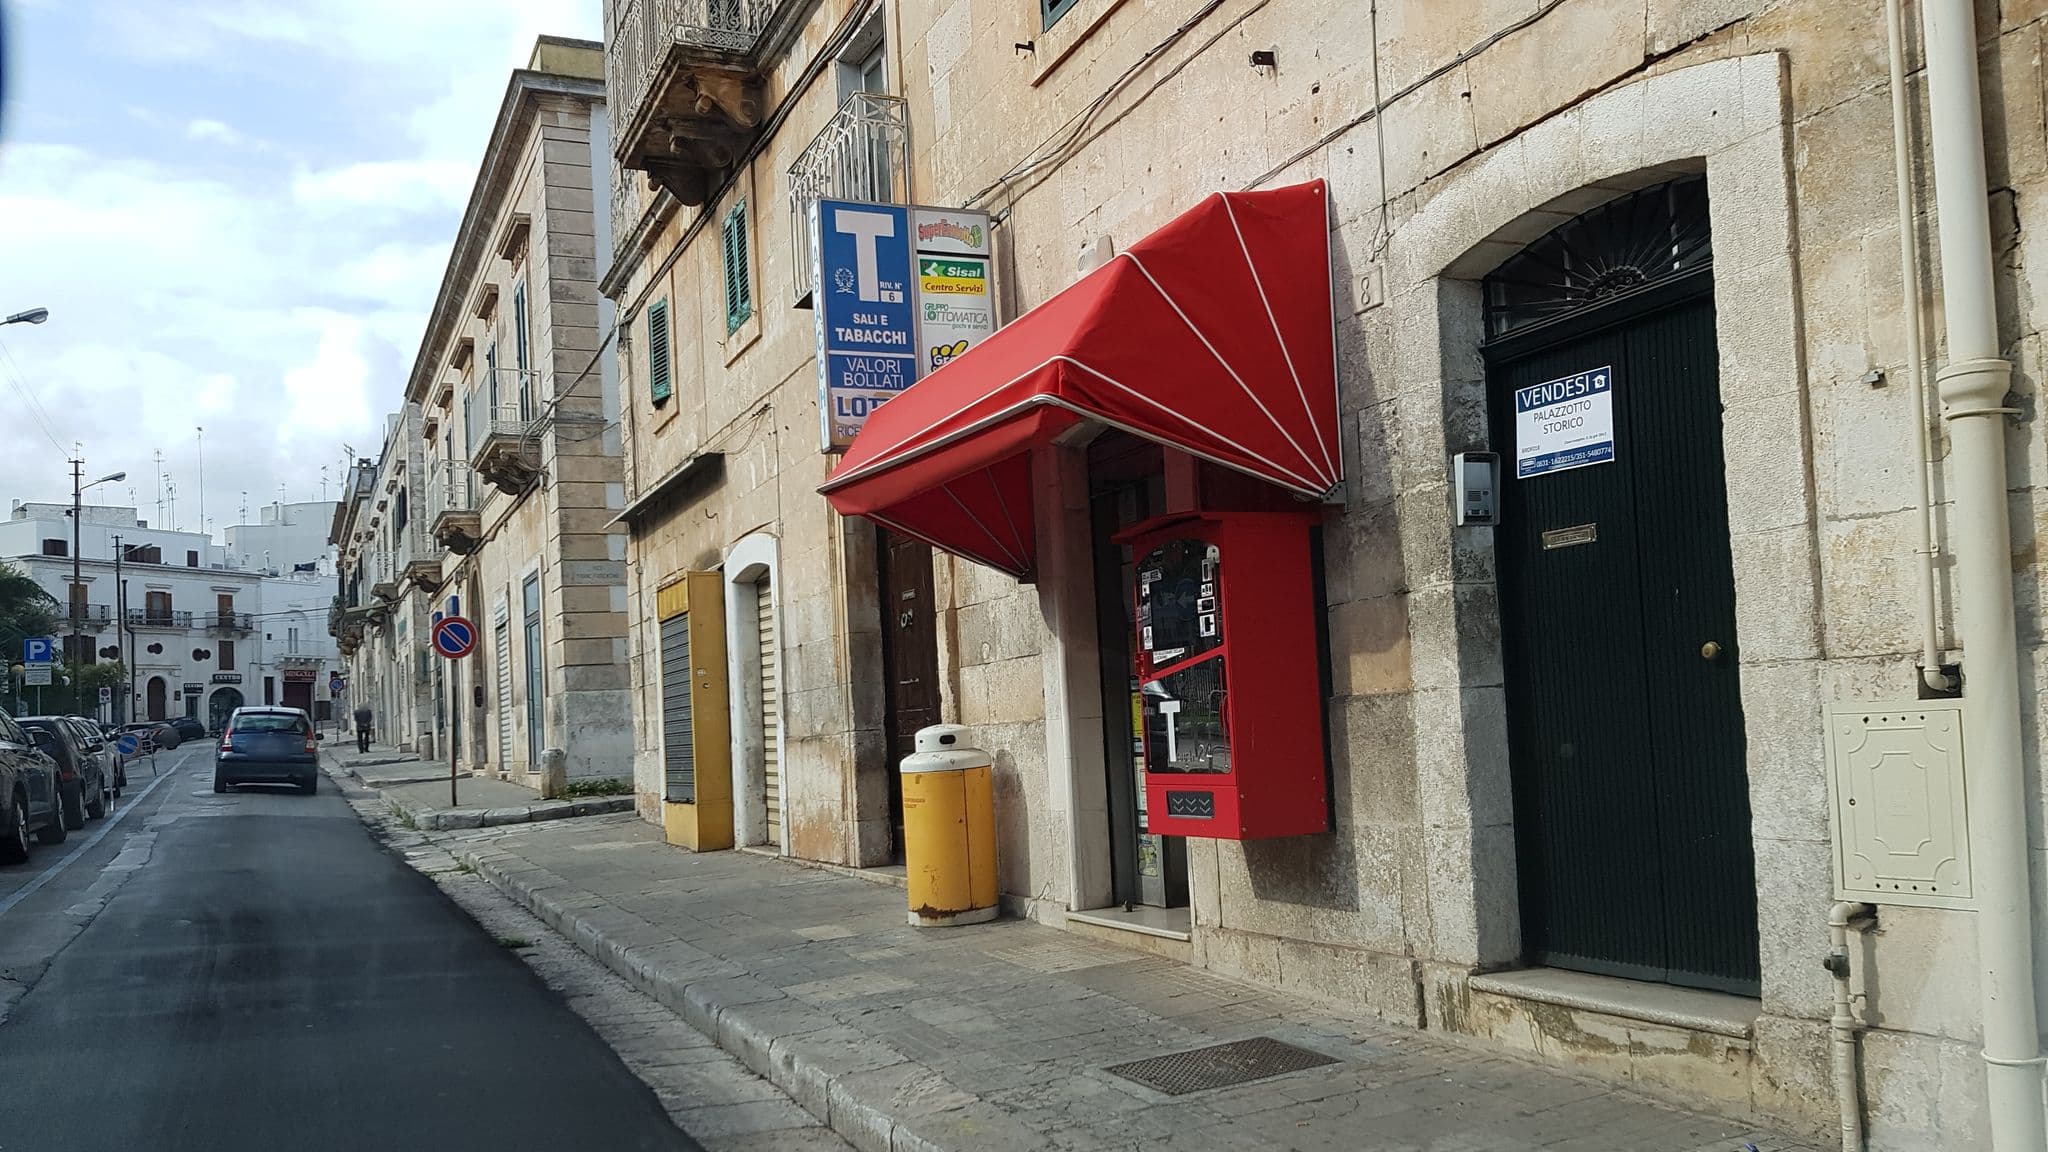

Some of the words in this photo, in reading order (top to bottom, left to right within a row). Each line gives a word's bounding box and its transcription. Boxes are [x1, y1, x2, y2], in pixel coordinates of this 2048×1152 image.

[835, 209, 895, 302] T
[946, 266, 980, 277] Sisal
[925, 282, 953, 291] Centro
[956, 283, 983, 293] Servizi
[888, 292, 896, 301] 6
[924, 302, 949, 311] GRUPPO
[853, 313, 878, 325] SALI
[881, 314, 889, 326] E
[924, 311, 989, 324] LOTTOMATICA
[835, 327, 907, 345] TABACCHI
[846, 357, 901, 374] VALORI
[843, 371, 904, 388] BOLLATI
[1521, 375, 1590, 408] VENDESI
[1533, 400, 1592, 422] PALAZZOTTO
[1543, 416, 1584, 435] STORICO
[29, 641, 46, 659] P
[1159, 700, 1181, 762] T
